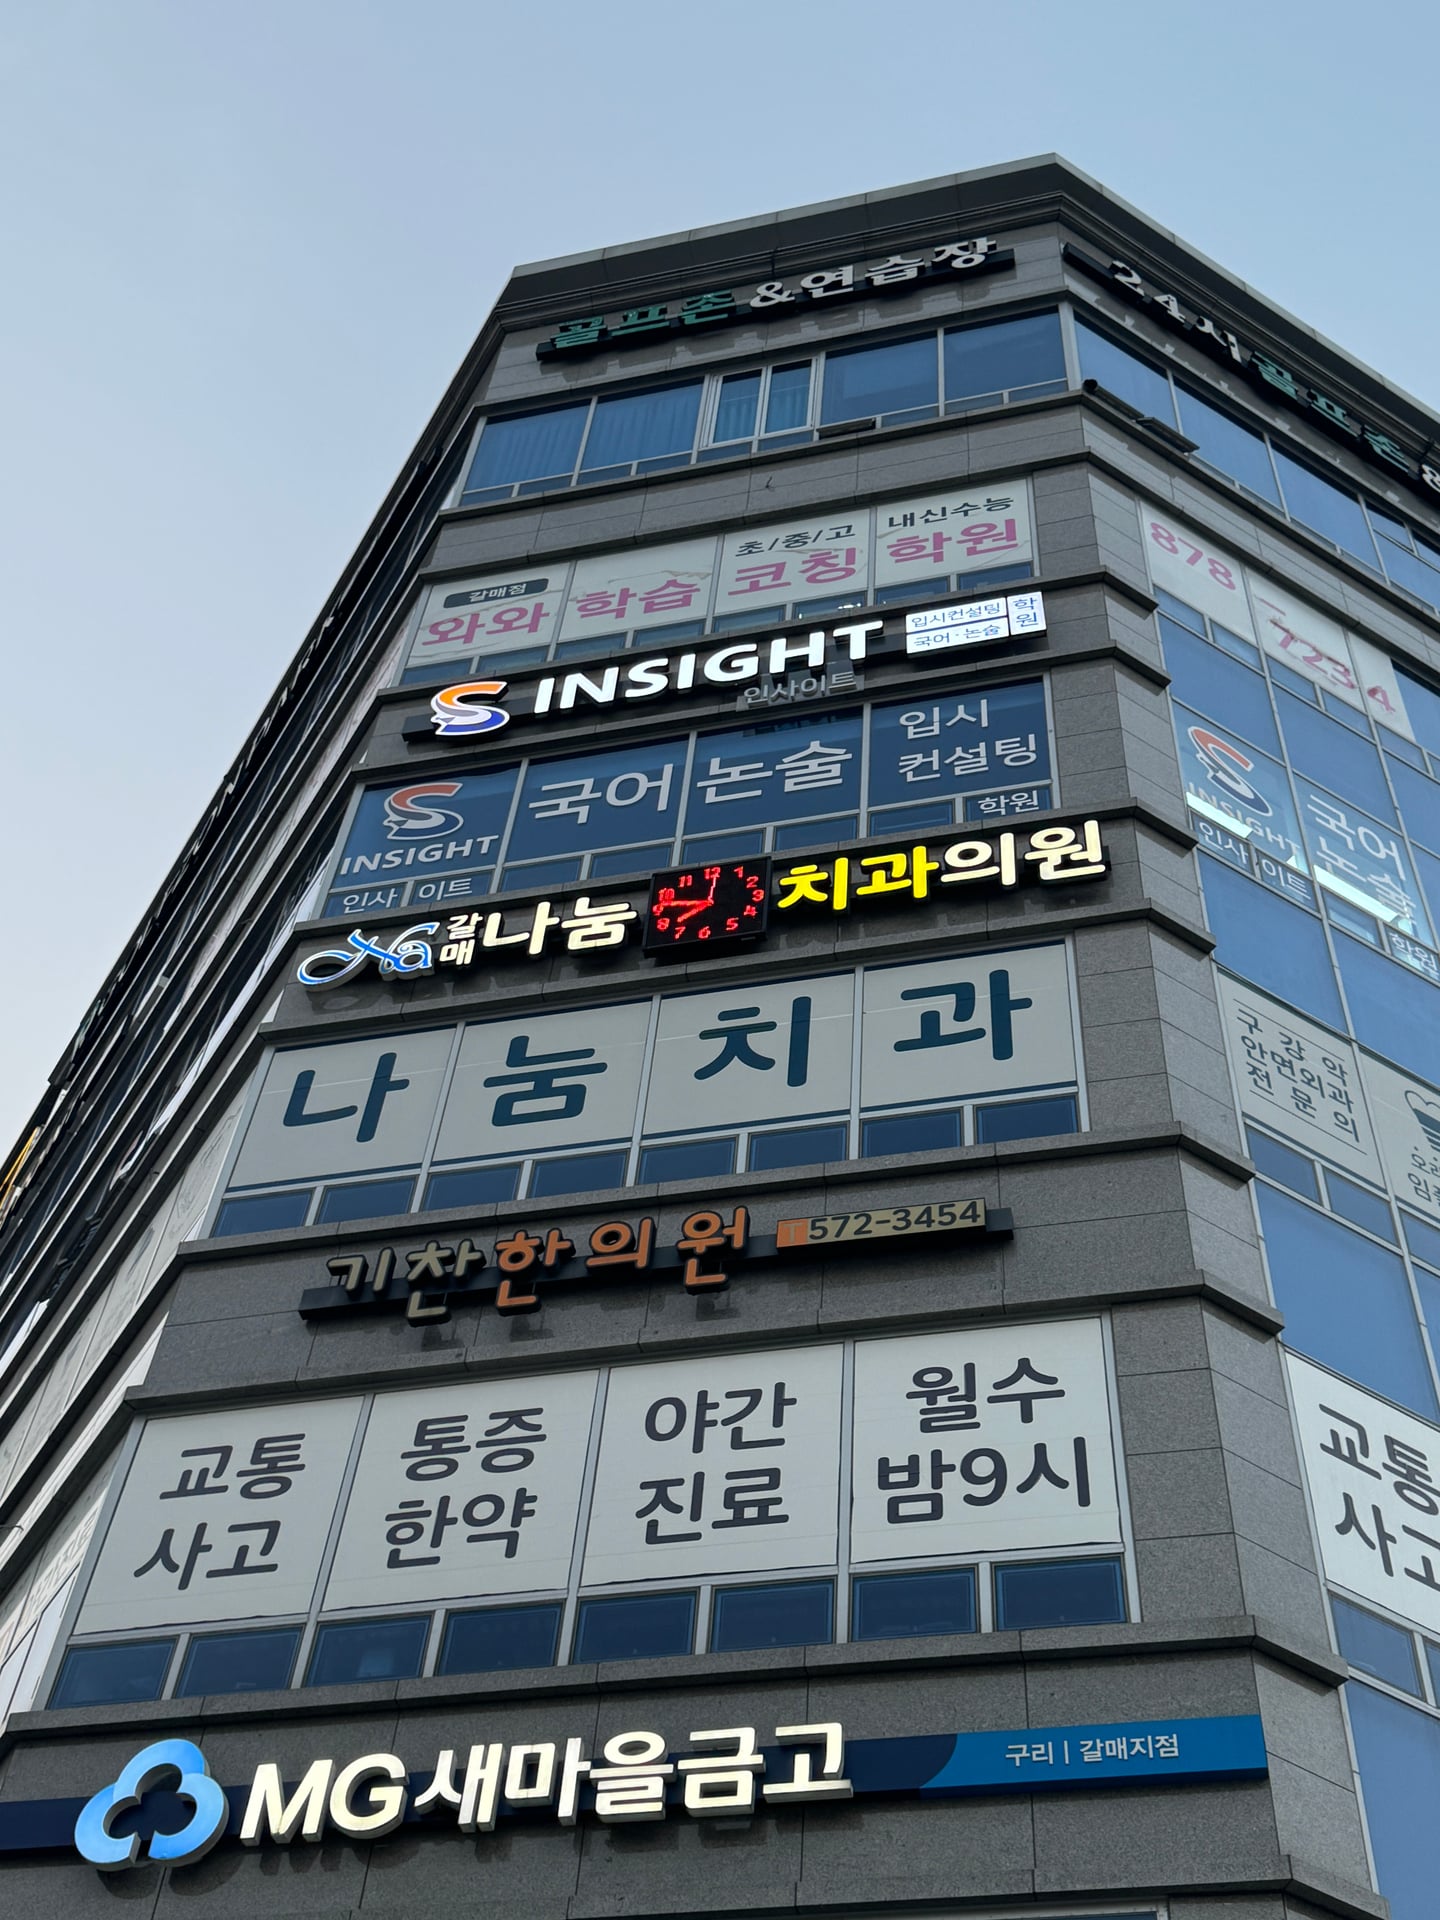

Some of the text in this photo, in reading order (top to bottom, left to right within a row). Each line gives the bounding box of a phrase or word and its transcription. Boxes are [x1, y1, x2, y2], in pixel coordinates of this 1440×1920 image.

[888, 496, 1014, 529] 내신수능
[421, 518, 1020, 646] 와와 학습 코칭 학원
[468, 582, 527, 603] 갈매점
[533, 620, 884, 715] INSIGHT
[743, 671, 857, 705] 인사이트
[899, 698, 989, 740] 입시
[528, 739, 853, 825] 국어 논술
[898, 733, 1037, 783] 컨설팅
[977, 789, 1040, 816] 학원
[1307, 794, 1406, 881] 국어
[340, 834, 499, 876] INSIGHT
[808, 1200, 981, 1241] 572-3454
[645, 1380, 798, 1456] 야간
[906, 1357, 1066, 1433] 월수
[159, 1432, 307, 1500] 교통
[401, 1406, 548, 1483] 통증
[634, 1466, 790, 1547] 진료
[876, 1436, 1091, 1526] 밤9시
[132, 1520, 280, 1592] 사고
[383, 1486, 537, 1570] 한약
[1005, 1733, 1181, 1767] 구리 갈매지점
